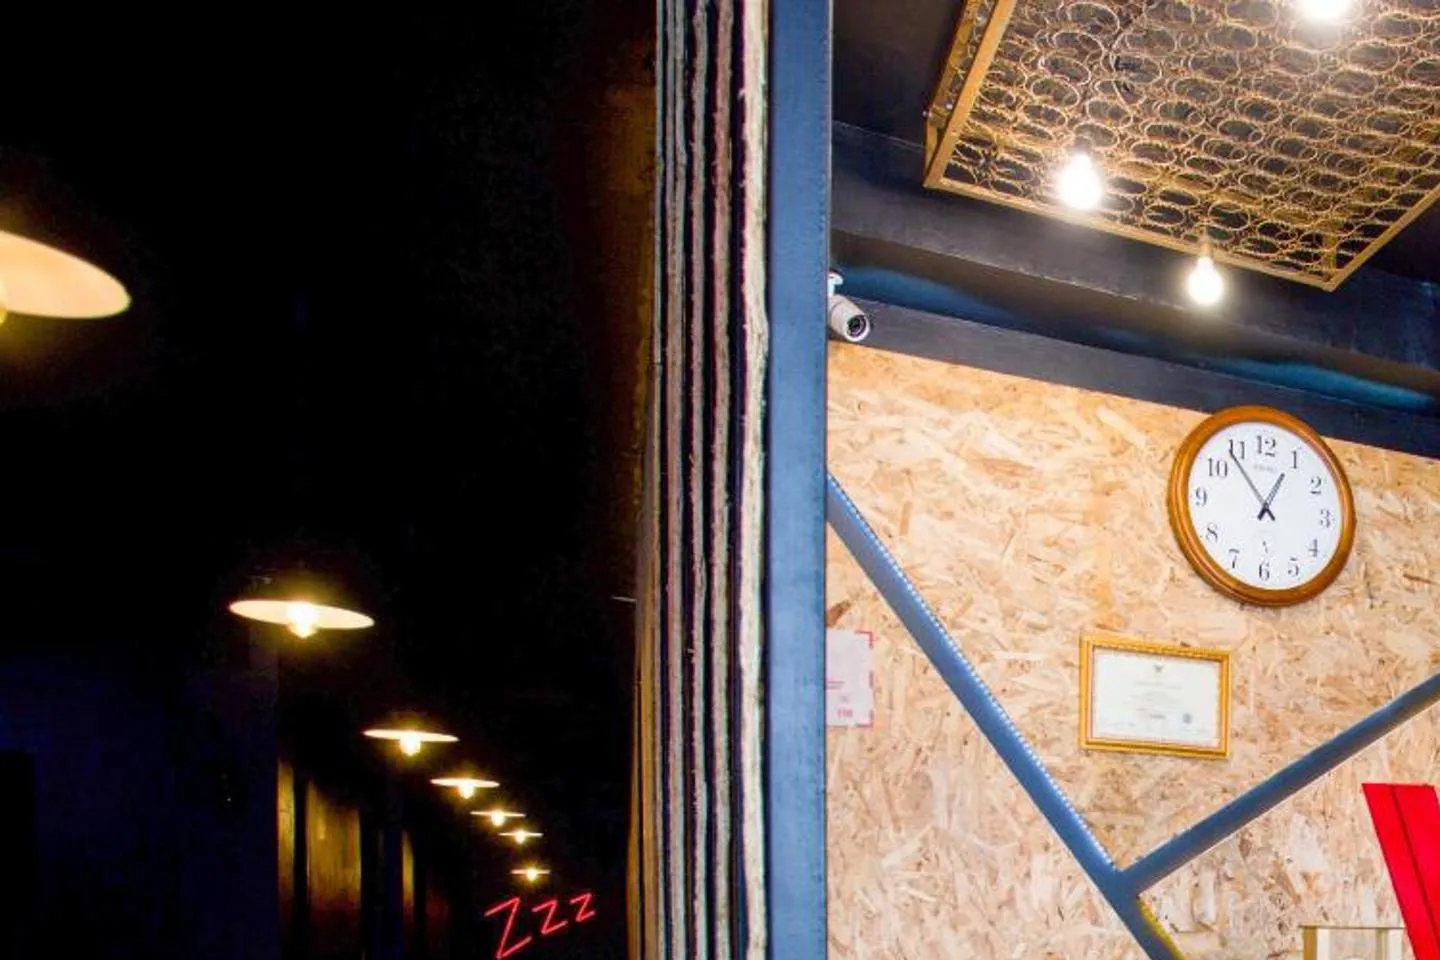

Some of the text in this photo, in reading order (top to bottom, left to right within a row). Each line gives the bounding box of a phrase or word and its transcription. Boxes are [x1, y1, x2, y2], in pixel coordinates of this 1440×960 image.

[1229, 439, 1246, 460] 11
[1256, 435, 1277, 457] 12
[1207, 457, 1229, 478] 10
[1291, 450, 1299, 469] 1
[1310, 476, 1323, 495] 2
[1195, 487, 1208, 506] 9
[1320, 508, 1333, 528] 3
[1206, 523, 1218, 543] 8
[1308, 538, 1319, 557] 4
[1228, 548, 1240, 568] 7
[1288, 557, 1300, 577] 5
[1258, 561, 1271, 581] 6
